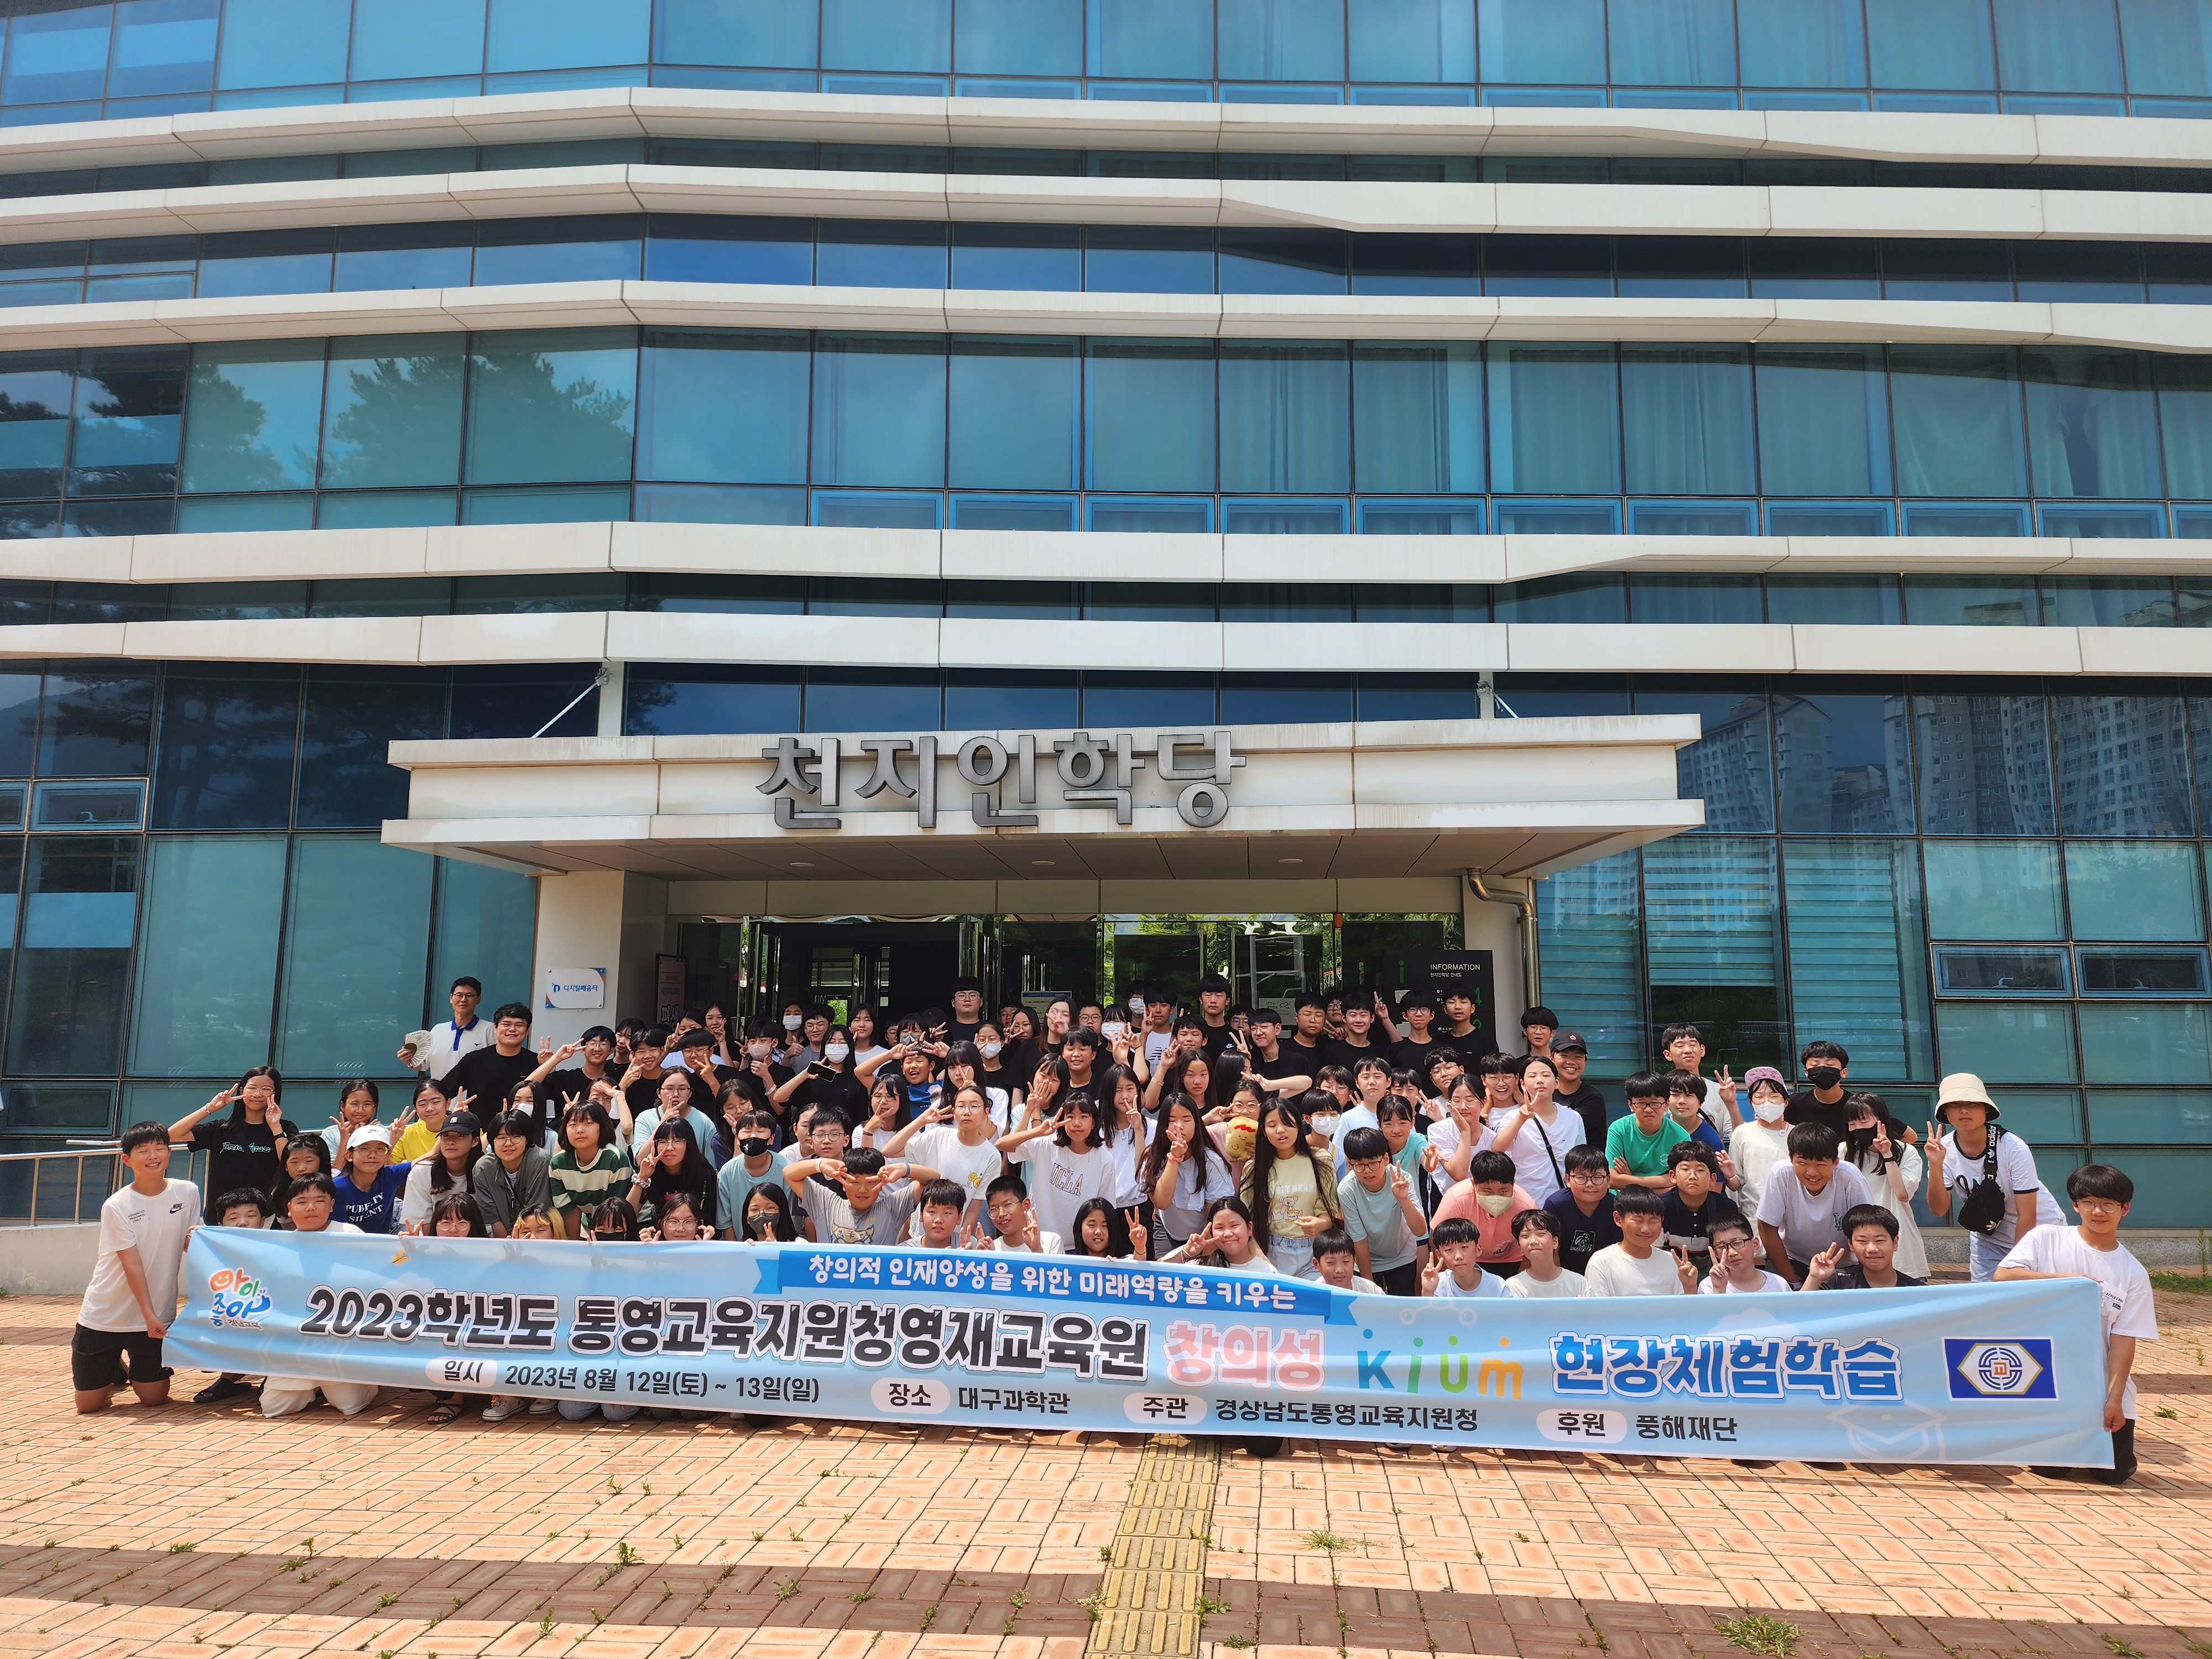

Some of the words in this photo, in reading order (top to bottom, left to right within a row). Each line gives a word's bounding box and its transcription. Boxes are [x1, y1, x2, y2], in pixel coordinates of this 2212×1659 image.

[755, 732, 1246, 829] 천지인학당
[1050, 1163, 1083, 1197] UCLA
[809, 1254, 881, 1285] 창의적
[890, 1257, 1014, 1291] 인재양성을
[1021, 1266, 1072, 1295] 위한
[1079, 1271, 1209, 1305] 미래역량을
[1217, 1282, 1296, 1310] 키우는
[227, 1319, 263, 1329] 경남교육
[299, 1286, 559, 1349] 2023학년도
[569, 1297, 1150, 1380] 통영교육지원청영재교육원
[1162, 1321, 1326, 1391] 창의성
[1550, 1332, 1903, 1400] 현장체험학습
[444, 1360, 483, 1383] 일시
[505, 1365, 577, 1390] 2023년
[583, 1368, 617, 1391] 8월
[626, 1371, 707, 1397] 12일(토)
[735, 1377, 820, 1404] 13일(일)
[889, 1384, 931, 1407] 장소
[958, 1387, 1071, 1414] 대구과학관
[1143, 1397, 1189, 1420] 주관
[1216, 1399, 1478, 1431] 경상남도통영교육지원청
[1557, 1412, 1606, 1437] 후원
[1636, 1415, 1738, 1442] 풍해재단
